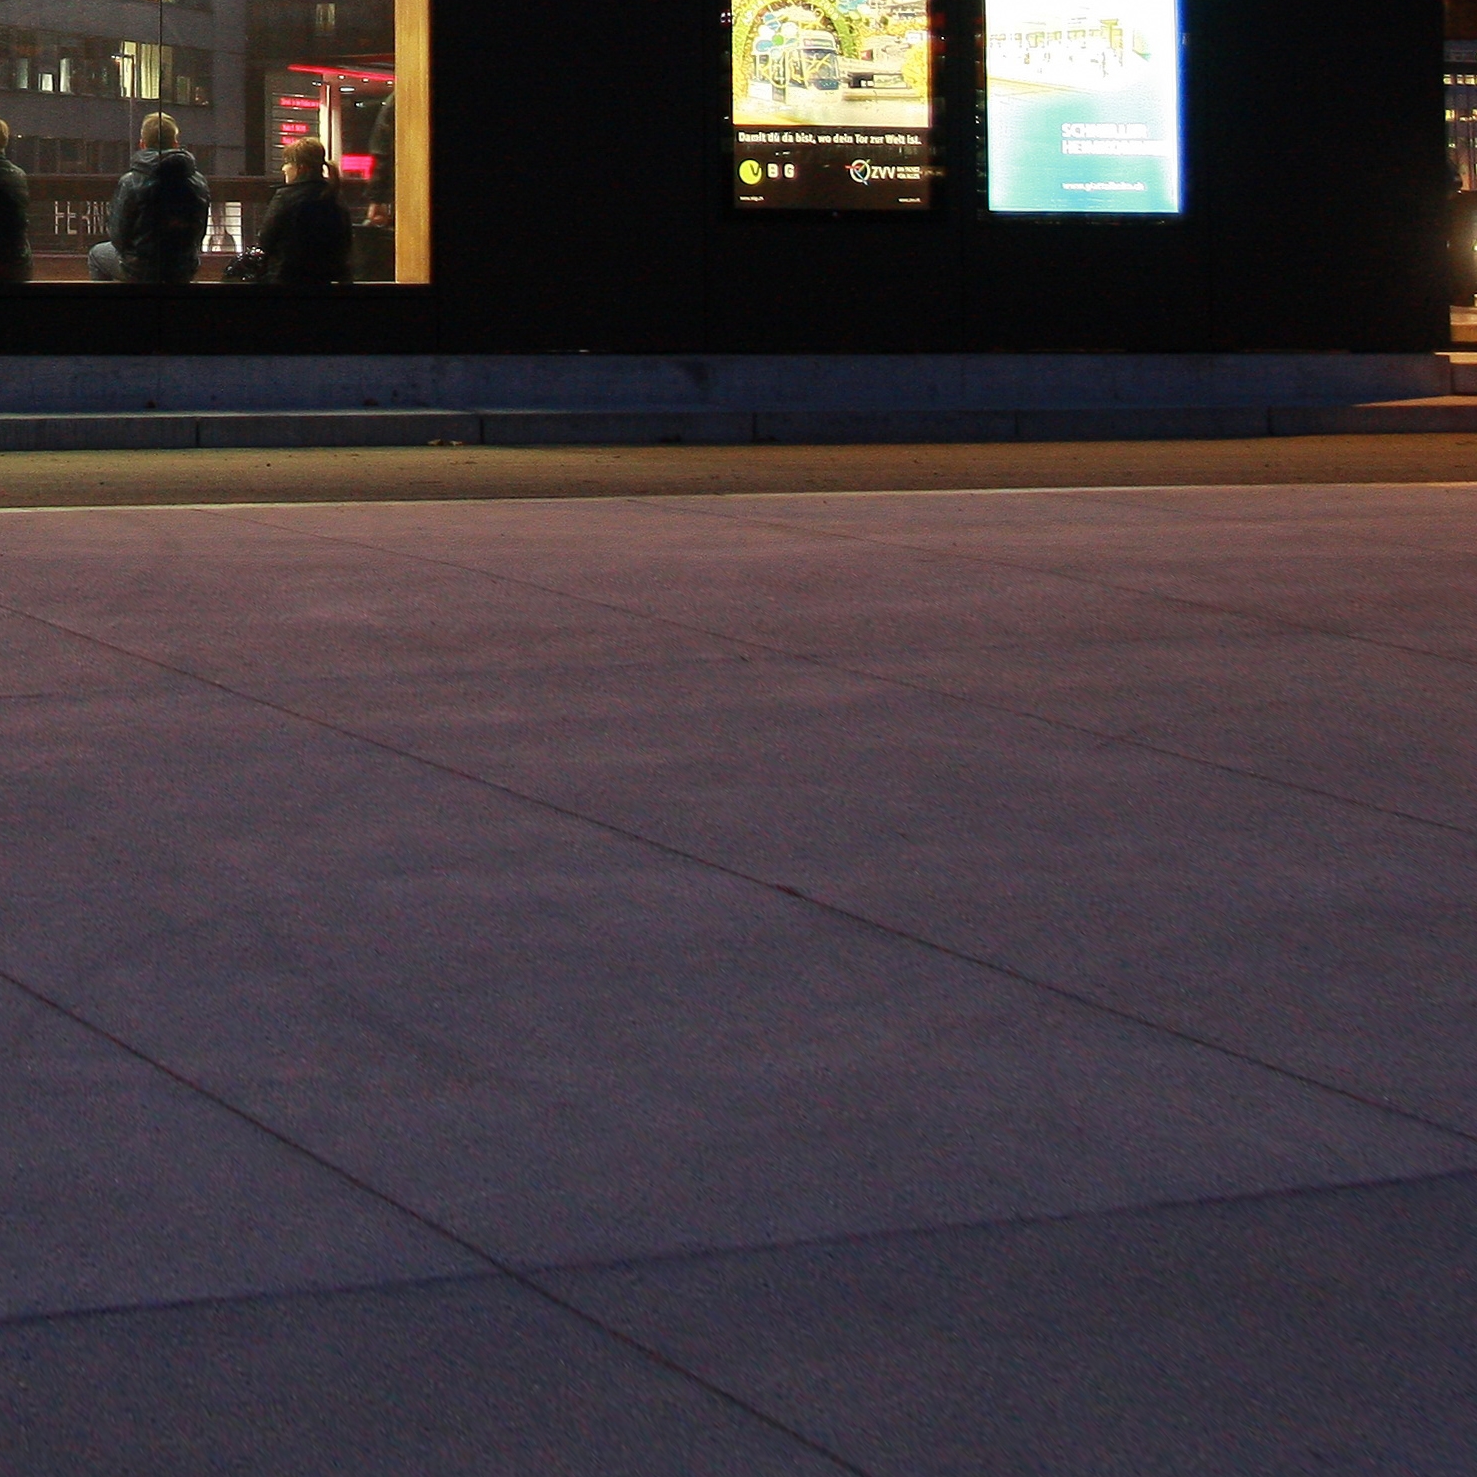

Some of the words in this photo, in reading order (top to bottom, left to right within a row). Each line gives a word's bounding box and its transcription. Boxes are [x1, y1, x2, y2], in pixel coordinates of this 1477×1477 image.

[738, 131, 767, 143] Damit
[781, 131, 794, 143] da
[795, 131, 817, 144] bist,
[817, 134, 832, 144] wo
[832, 133, 854, 144] dein
[854, 133, 868, 144] Tor
[869, 135, 884, 145] zur
[885, 134, 906, 145] Welt
[906, 134, 923, 145] ist.
[871, 165, 896, 179] ZVV
